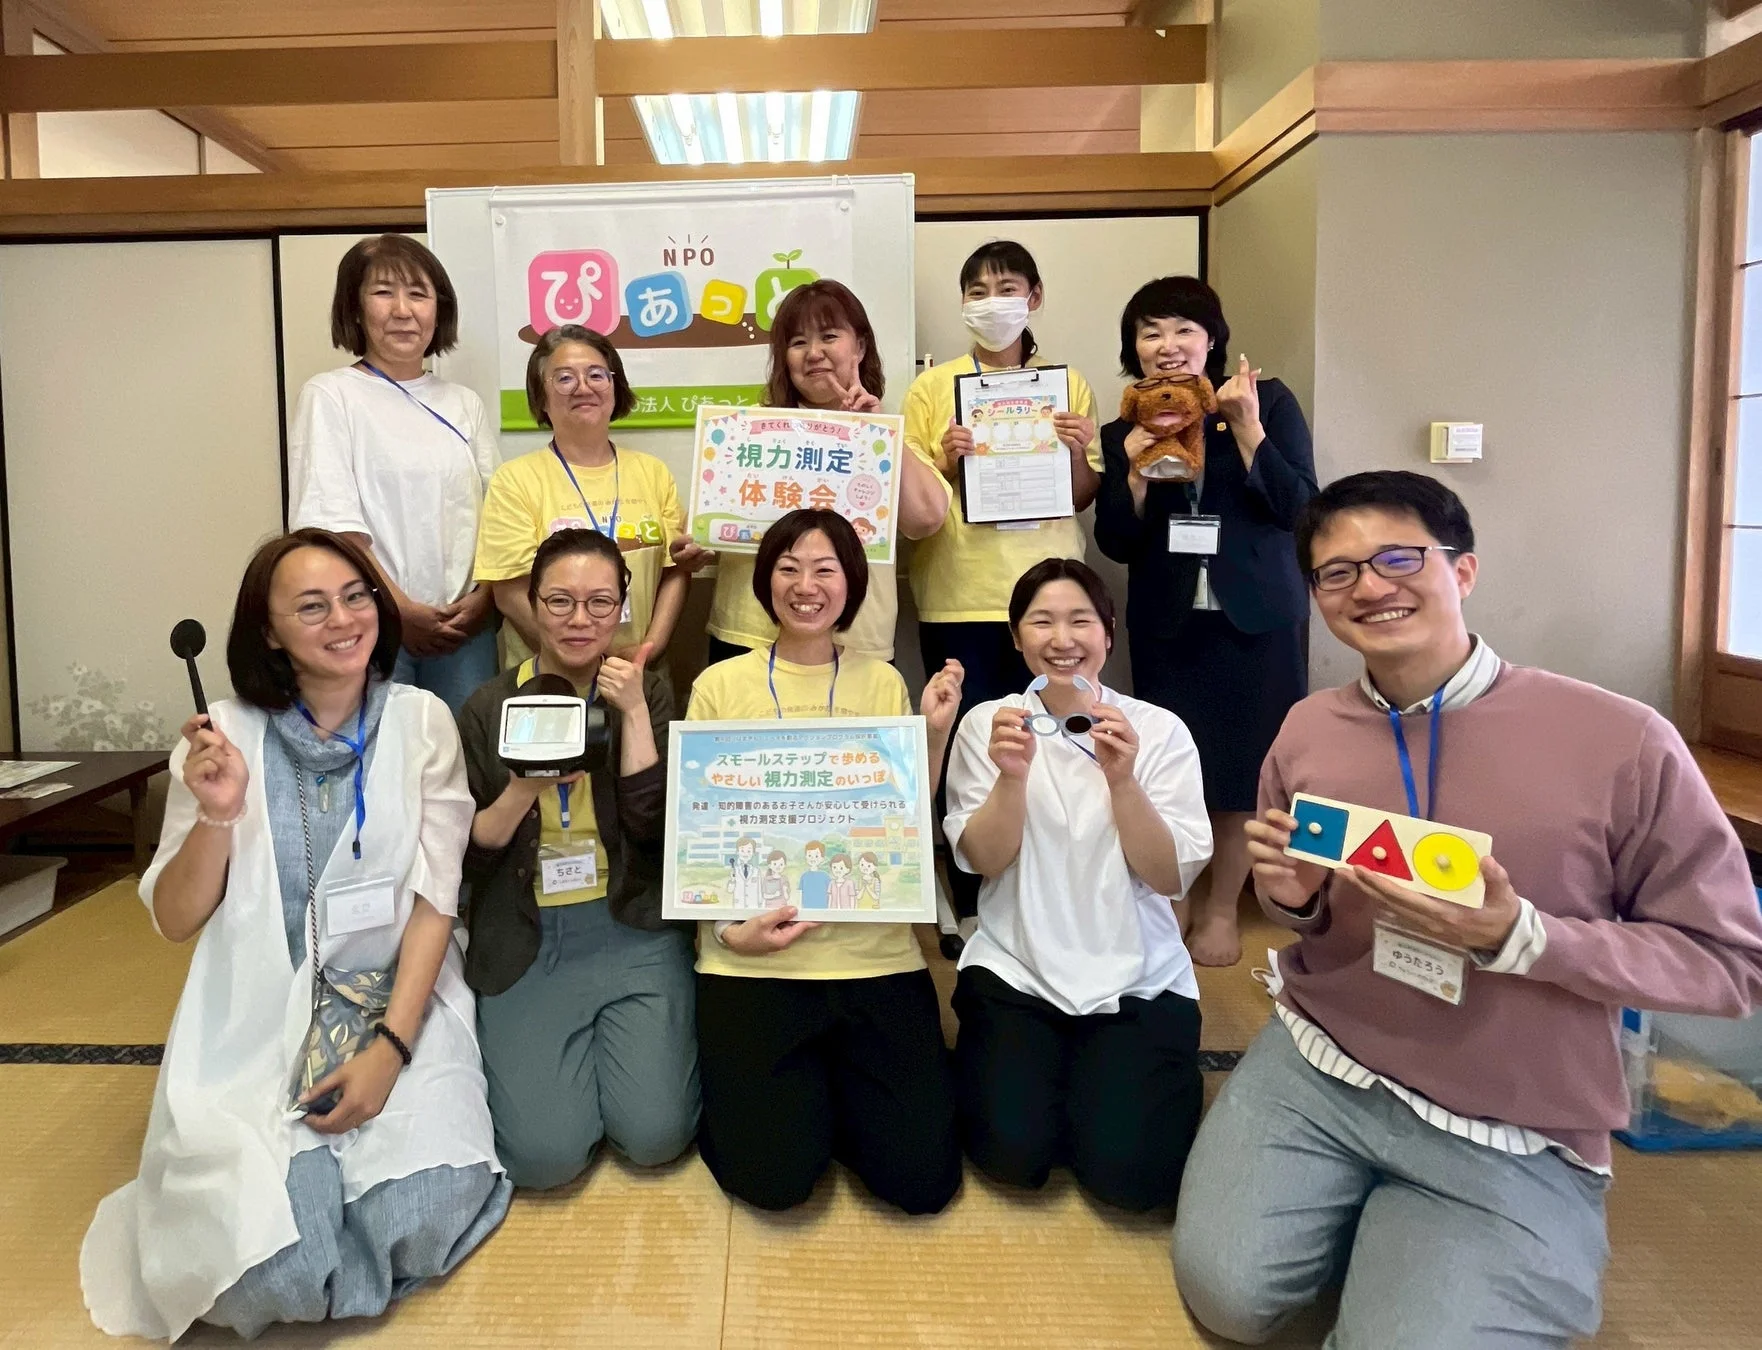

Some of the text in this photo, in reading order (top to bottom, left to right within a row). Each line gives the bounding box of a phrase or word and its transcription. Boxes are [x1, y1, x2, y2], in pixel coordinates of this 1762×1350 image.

[663, 247, 715, 267] NPO
[987, 406, 1038, 416] シールラリー
[736, 443, 854, 475] 視力測定
[738, 479, 838, 510] 体験会
[717, 752, 881, 766] スモールステップで歩める
[739, 813, 856, 825] 視力測定支援プロジェクト
[557, 866, 582, 877] ちさと
[1392, 950, 1444, 975] ゆうたろう
